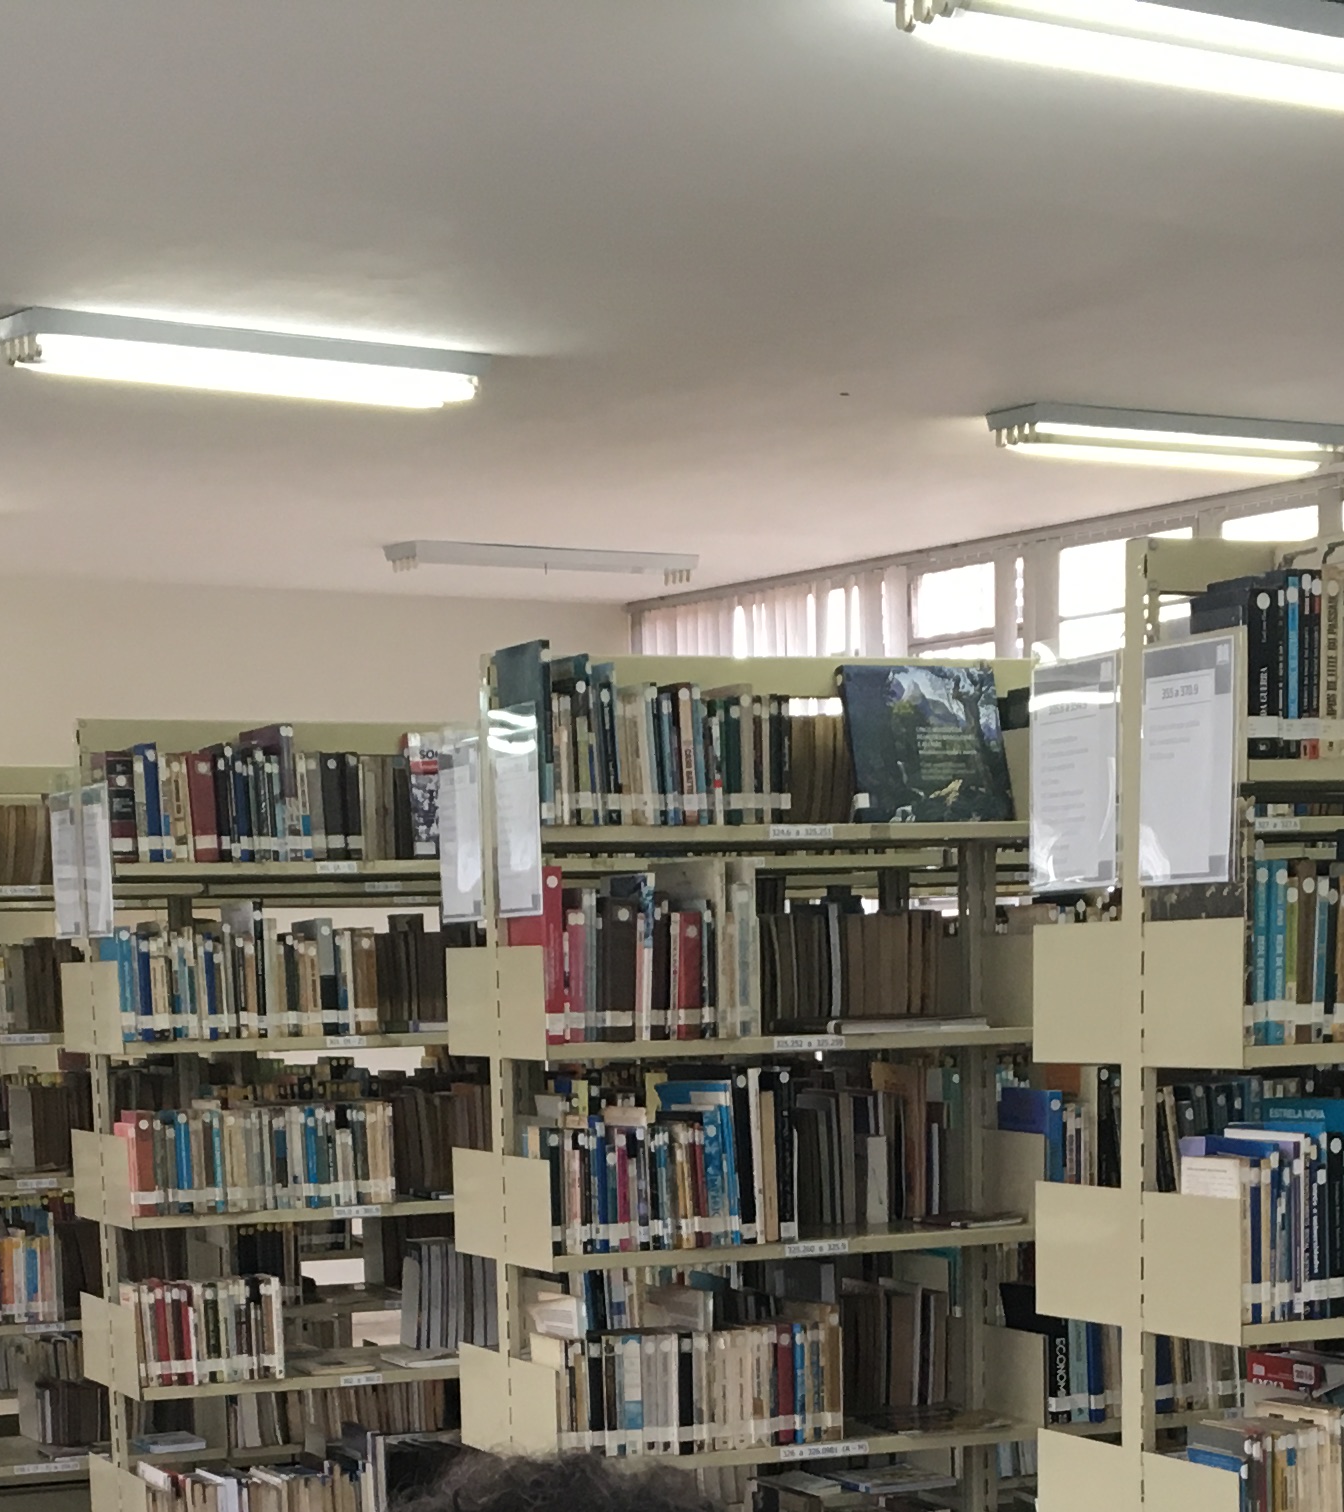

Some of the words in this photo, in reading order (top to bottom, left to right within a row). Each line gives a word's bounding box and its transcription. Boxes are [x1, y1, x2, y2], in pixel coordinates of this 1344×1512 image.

[1259, 666, 1270, 704] GUERRA
[1269, 1107, 1303, 1119] ESTRELA
[1303, 1108, 1326, 1120] NOVA
